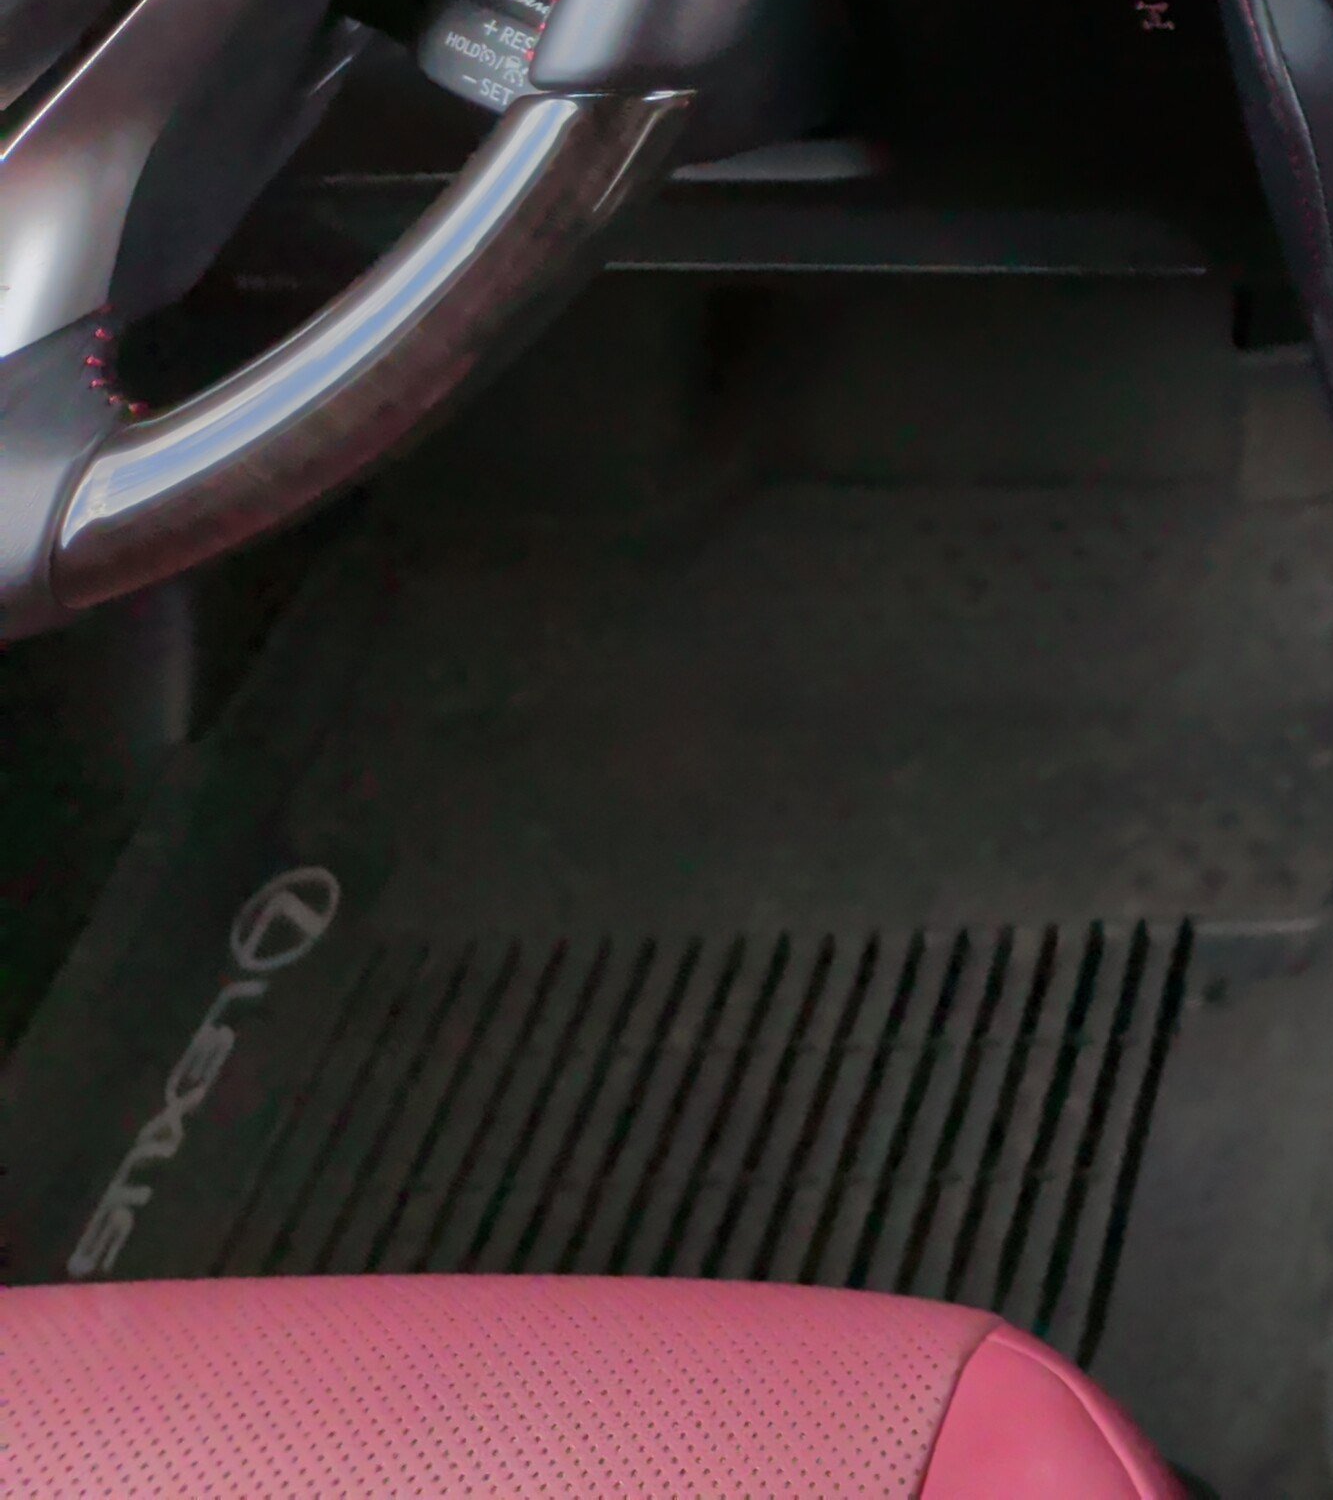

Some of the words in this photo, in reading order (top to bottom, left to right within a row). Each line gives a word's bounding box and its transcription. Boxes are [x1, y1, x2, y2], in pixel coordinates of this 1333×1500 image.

[445, 31, 482, 58] HOLD
[500, 25, 537, 54] RES
[480, 77, 514, 106] SET
[66, 979, 270, 1276] LEXUS
